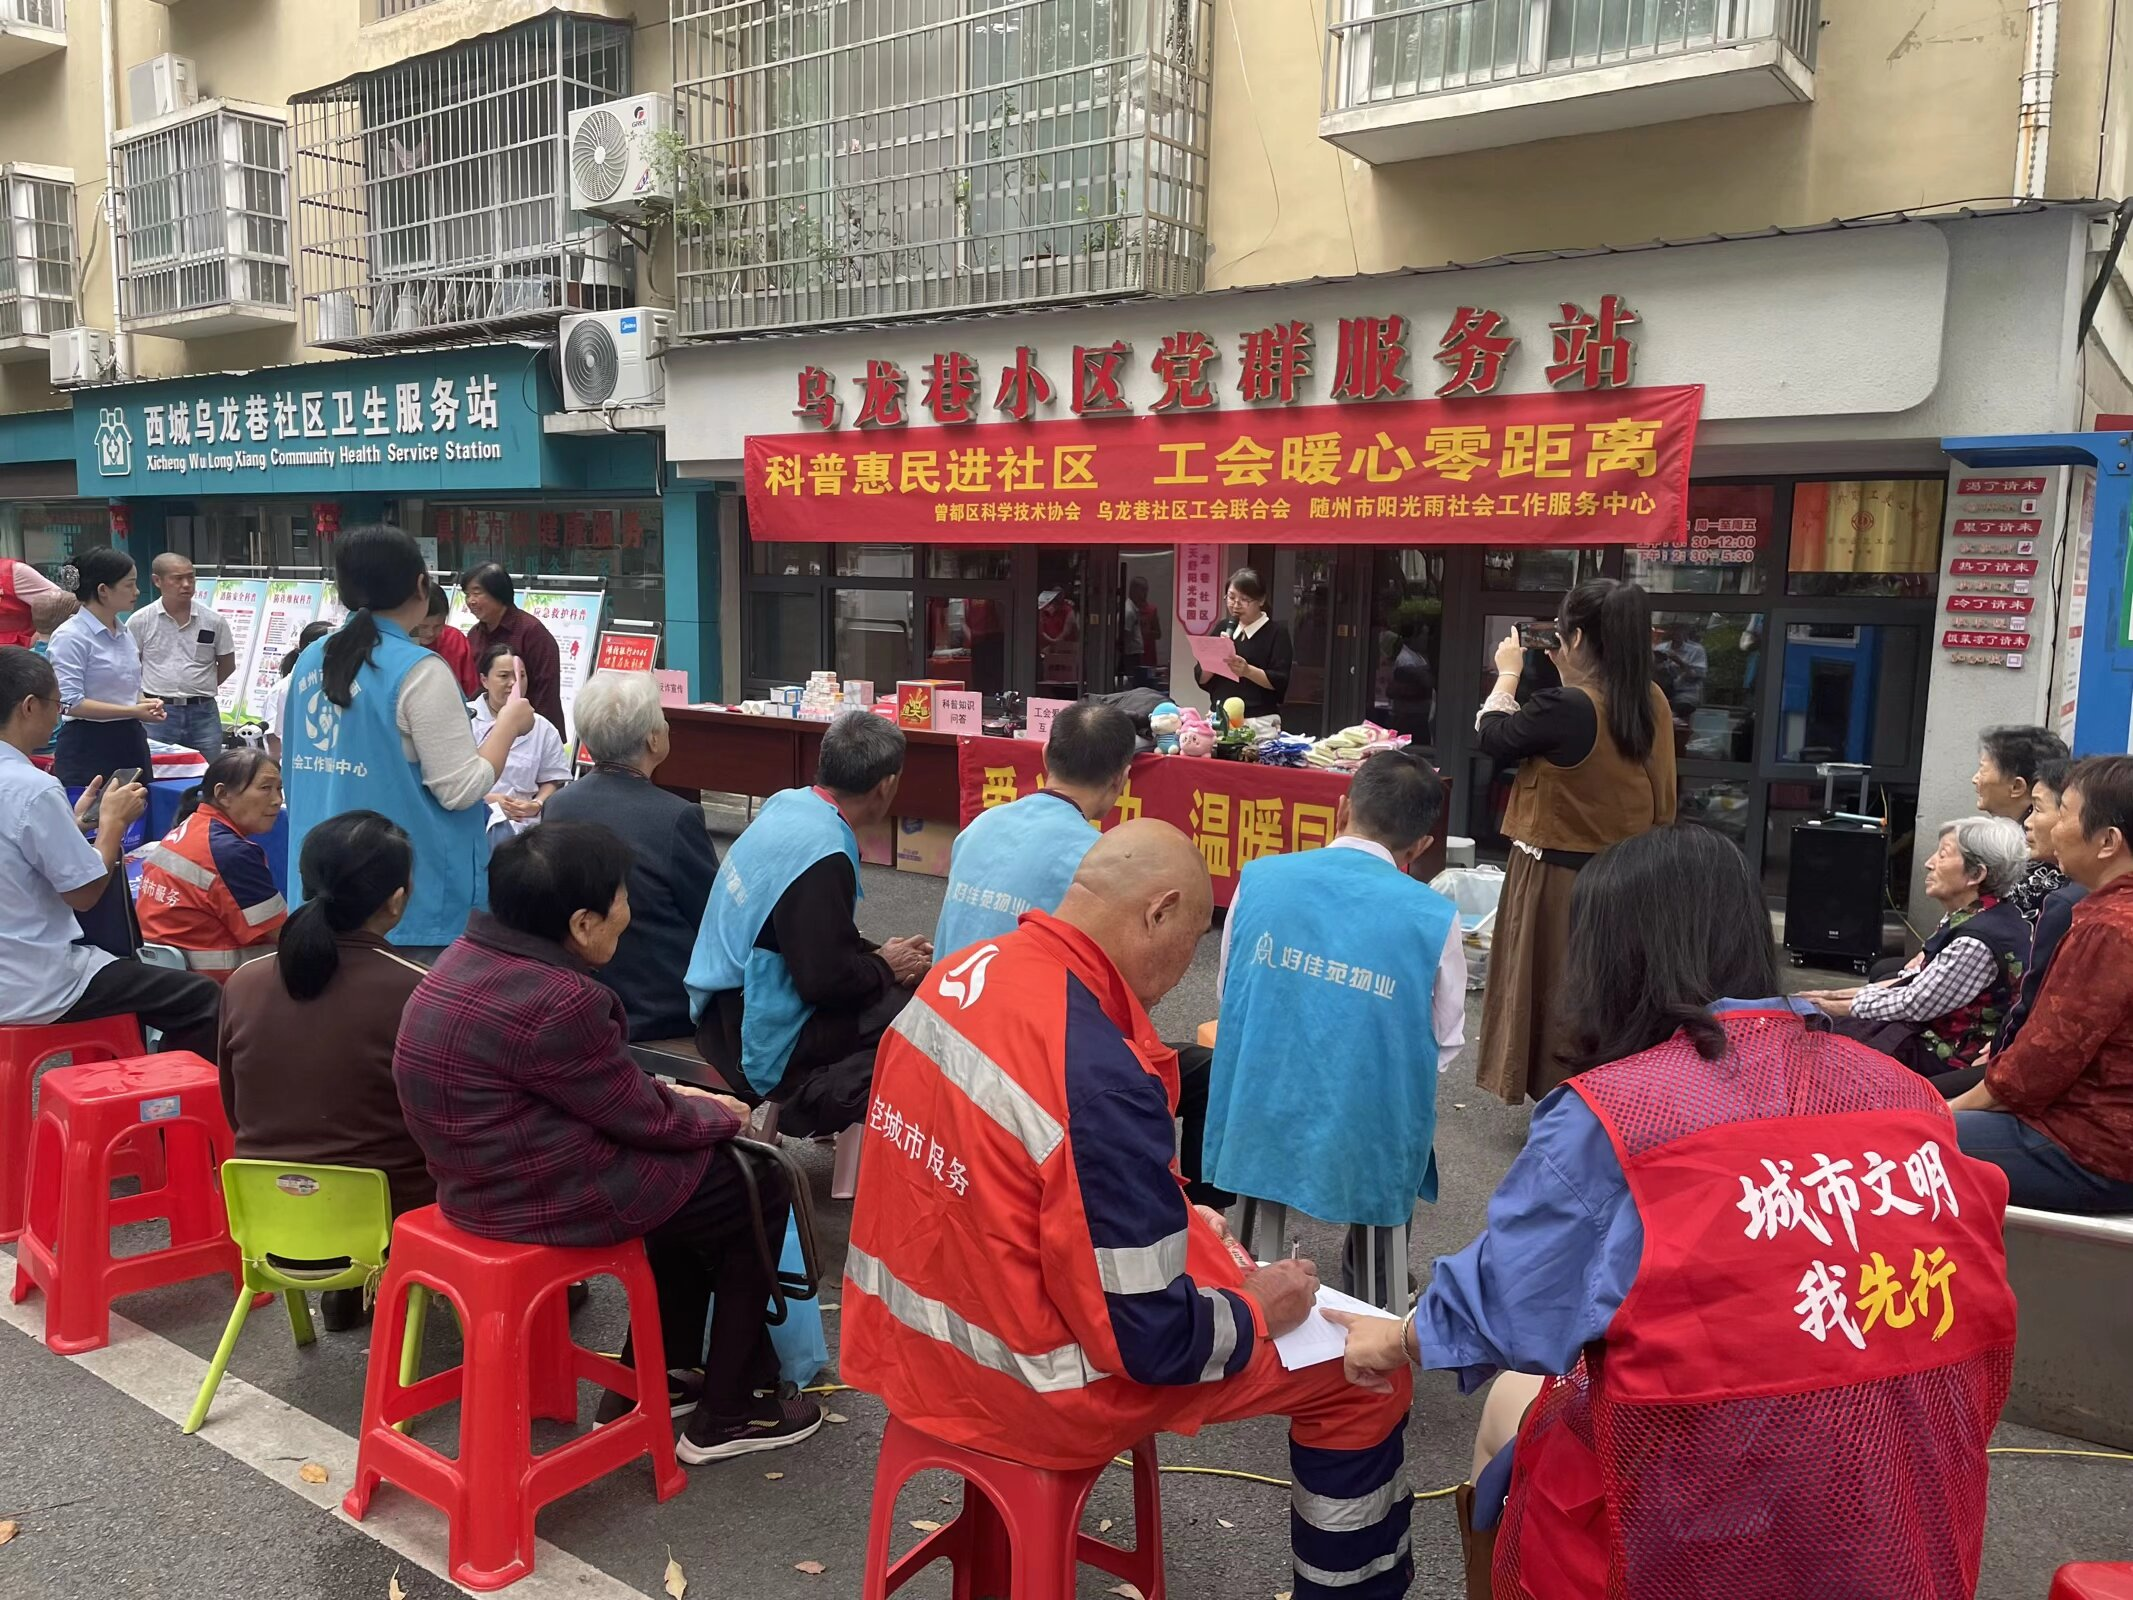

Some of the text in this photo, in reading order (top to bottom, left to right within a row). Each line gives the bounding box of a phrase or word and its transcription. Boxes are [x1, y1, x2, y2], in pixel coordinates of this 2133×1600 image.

[793, 294, 1642, 430] 乌龙巷小区党群服务站
[143, 374, 499, 447] 西城乌龙巷社区卫生服务站
[147, 454, 187, 474] Xicheng
[235, 450, 267, 471] Xiang
[270, 447, 335, 468] Community
[340, 445, 381, 464] Health
[387, 442, 438, 462] Service
[445, 440, 502, 460] Station
[764, 418, 1663, 496] 科普惠民进社区 工会暖心零距离
[934, 490, 1656, 523] 曾都区科学技术协会 乌龙巷社区工会联合会 随州市阳光雨社会工作服务中心
[533, 607, 588, 621] 应急救护科普
[1199, 544, 1212, 621] 龙巷社区
[942, 699, 975, 711] 科普知识
[950, 713, 967, 725] 问答
[1280, 946, 1396, 1000] 好佳苑物业
[1736, 1140, 1960, 1253] 城市文明
[1793, 1246, 1957, 1350] 我先行
